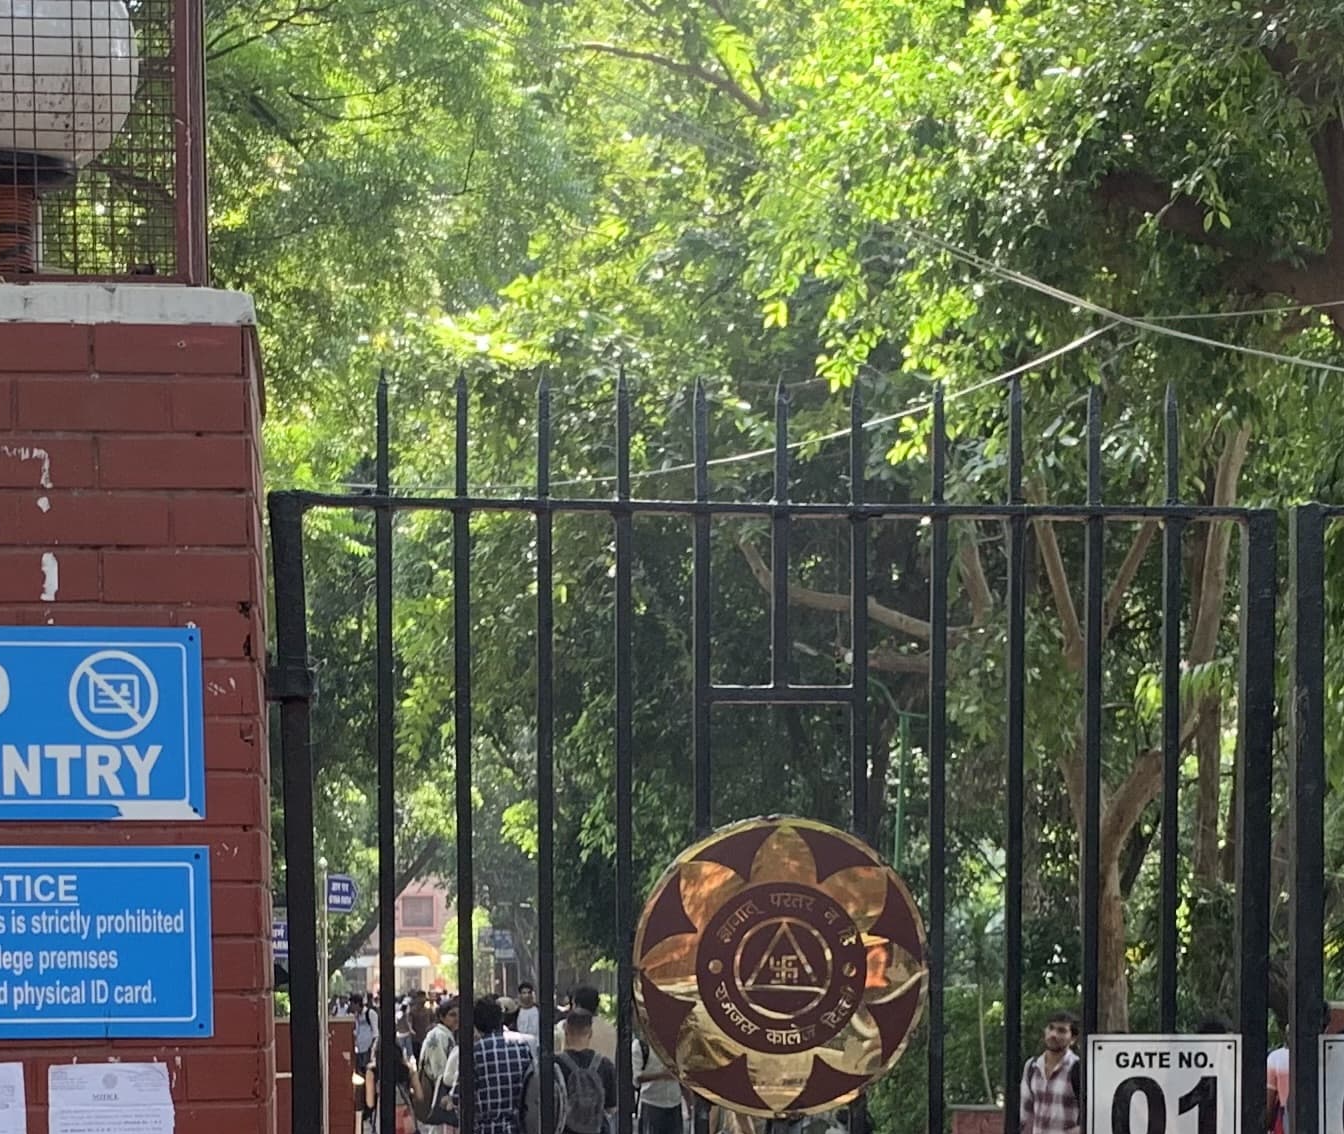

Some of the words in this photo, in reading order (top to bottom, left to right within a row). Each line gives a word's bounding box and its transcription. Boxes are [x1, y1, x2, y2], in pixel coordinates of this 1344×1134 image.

[11, 910, 27, 933] is
[31, 910, 92, 940] strictly
[97, 909, 184, 940] prohibited
[39, 948, 119, 977] premises
[13, 980, 86, 1011] physical
[91, 980, 109, 1003] ID
[114, 980, 157, 1005] card.
[1115, 1051, 1171, 1069] GATE
[1179, 1051, 1214, 1069] NO.
